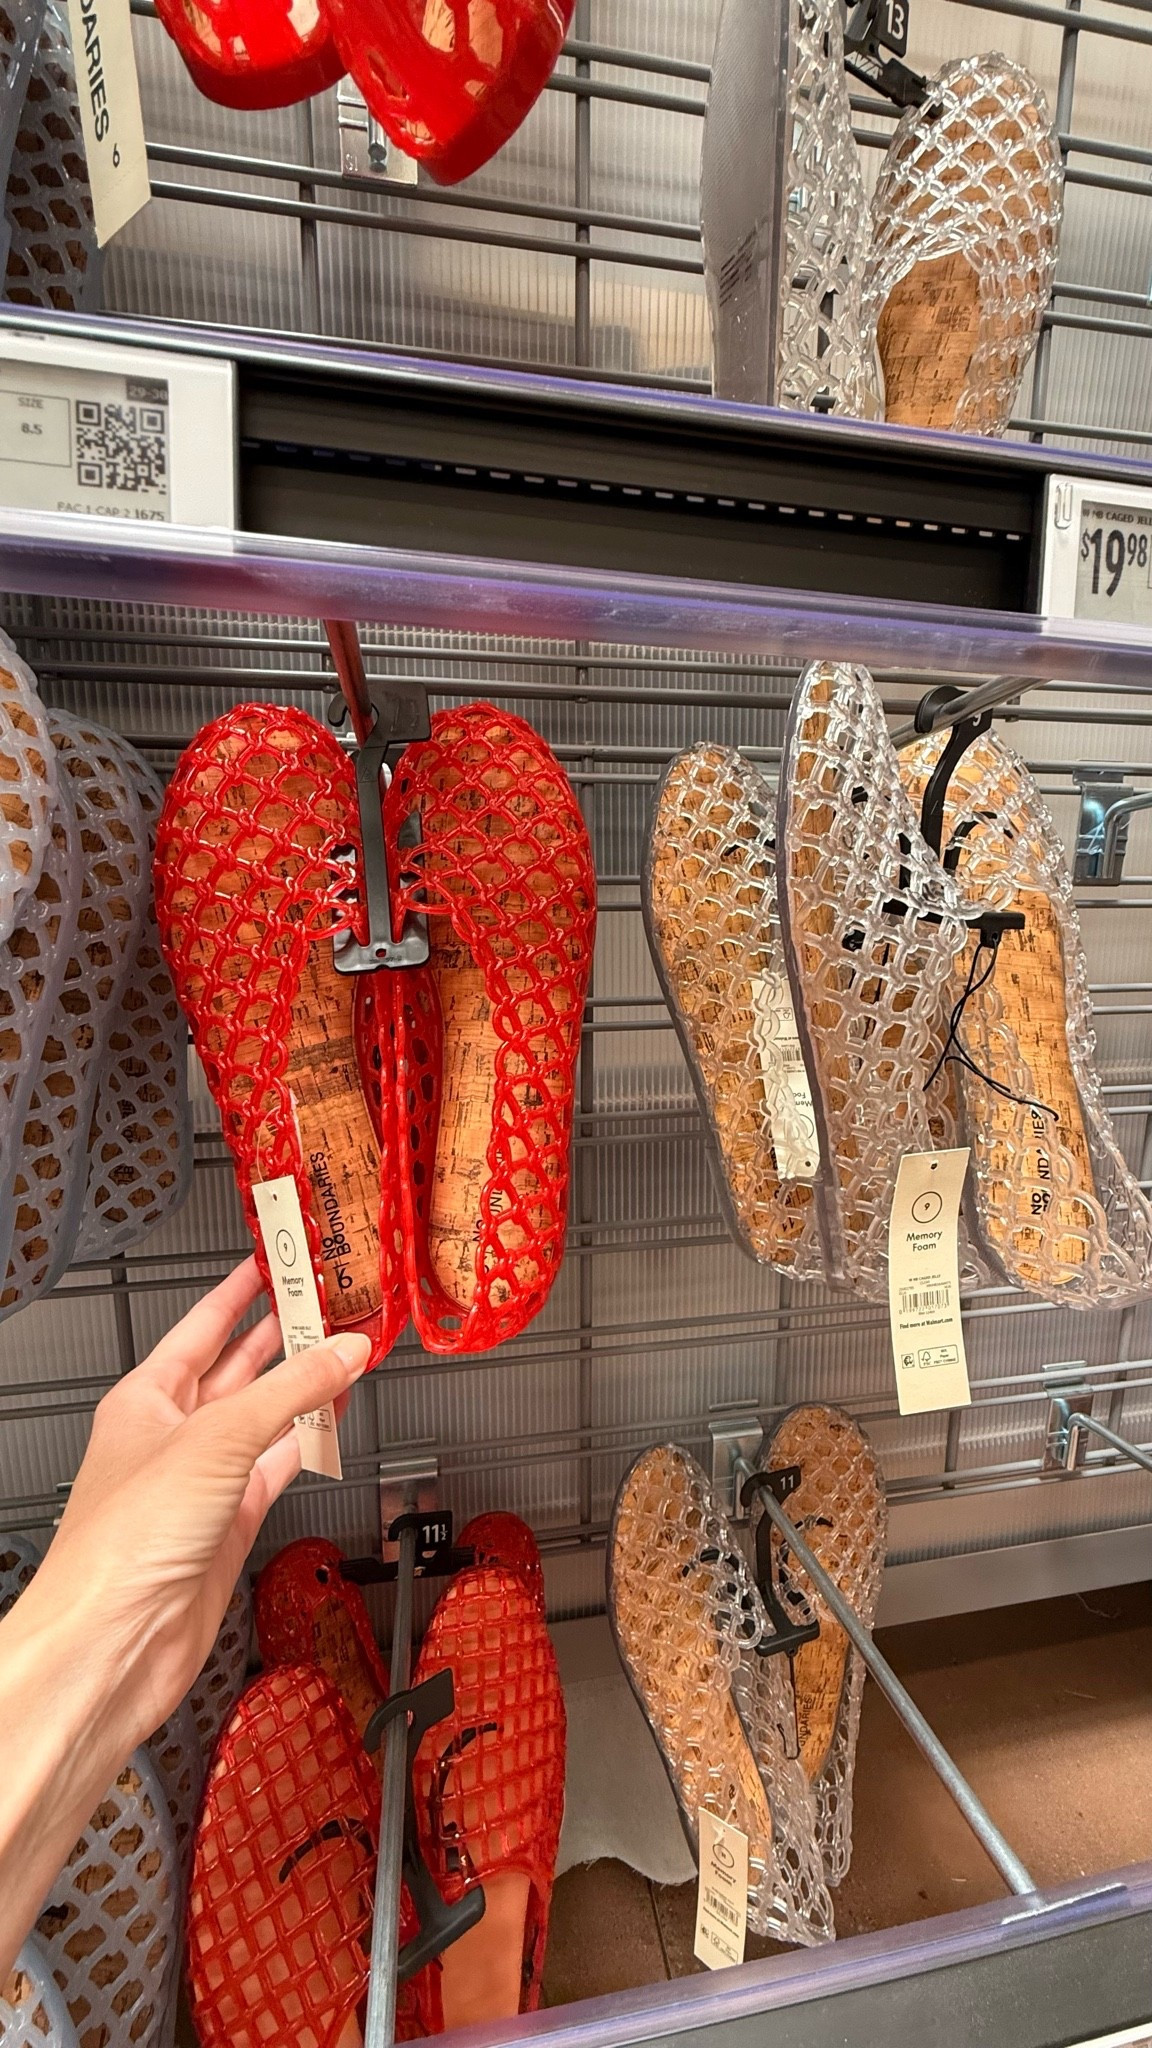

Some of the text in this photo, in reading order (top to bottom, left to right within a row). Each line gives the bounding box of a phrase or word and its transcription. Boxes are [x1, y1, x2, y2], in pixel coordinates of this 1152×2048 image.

[886, 0, 905, 40] 13
[18, 396, 44, 409] SIZE
[96, 504, 119, 517] CAP
[135, 507, 165, 521] 1675
[1105, 511, 1134, 523] CAGED
[310, 1151, 352, 1256] BOUNDARIES
[1031, 1193, 1041, 1215] NO
[906, 1230, 943, 1242] Memory
[322, 1237, 338, 1261] NO
[912, 1242, 937, 1252] Foam
[282, 1276, 304, 1288] Memory
[288, 1287, 303, 1297] Foam
[780, 1474, 794, 1490] 11
